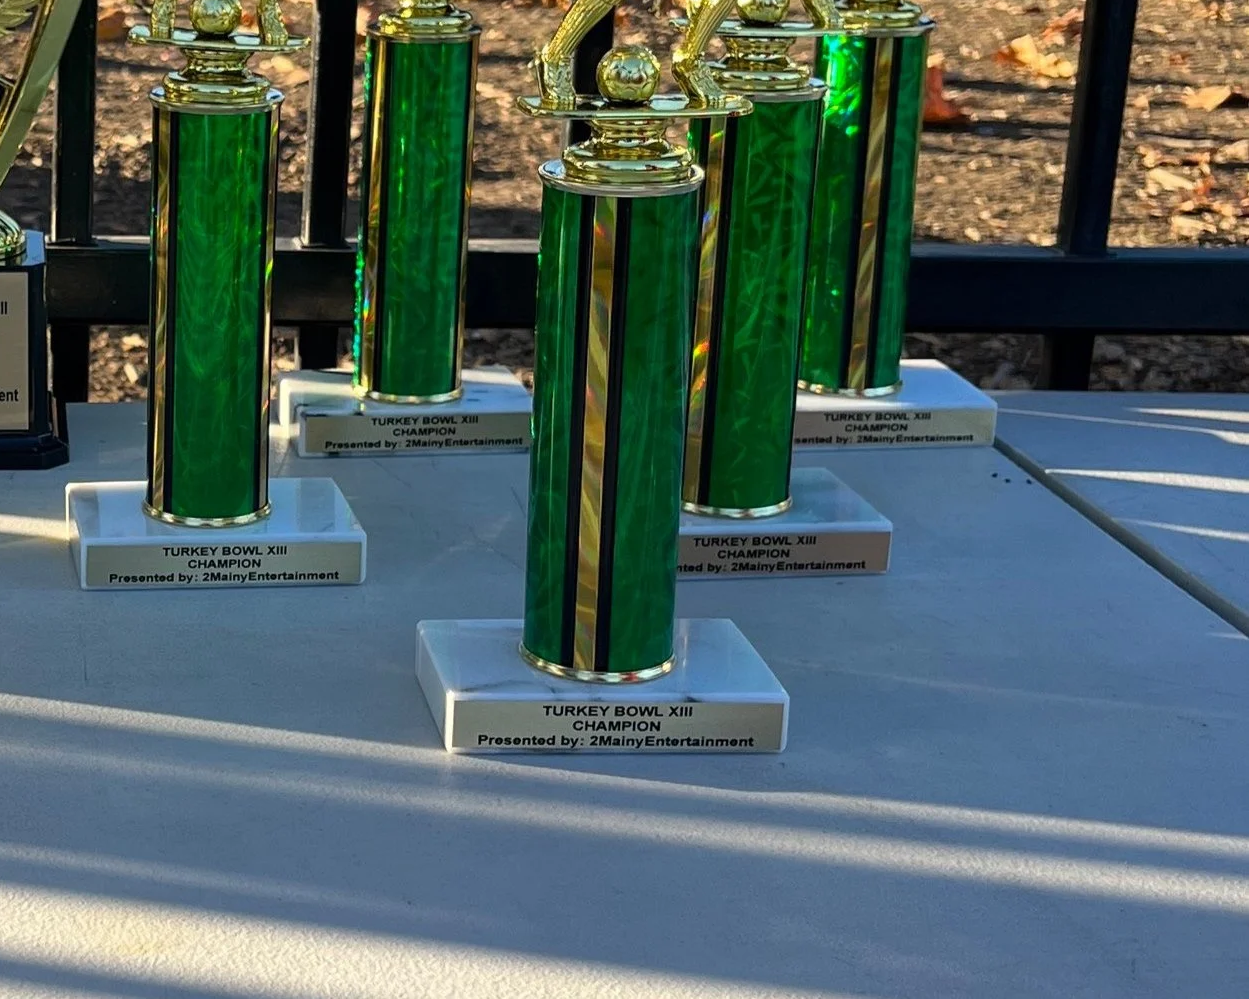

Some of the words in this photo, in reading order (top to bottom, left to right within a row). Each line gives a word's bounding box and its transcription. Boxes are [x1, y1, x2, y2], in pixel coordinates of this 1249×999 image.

[372, 417, 420, 426] TURKEY
[423, 416, 457, 425] BOWL
[461, 416, 478, 424] XIII
[824, 413, 871, 422] TURKEY
[875, 413, 910, 421] BOWL
[914, 412, 931, 420] XIII
[393, 428, 456, 436] CHAMPION
[845, 424, 908, 432] CHAMPION
[325, 441, 381, 449] Presented
[406, 438, 523, 450] 2MainyEntertainment
[794, 436, 832, 444] sented
[693, 537, 748, 547] TURKEY
[752, 537, 791, 546] BOWL
[797, 536, 817, 545] XIII
[163, 547, 218, 556] TURKEY
[222, 546, 262, 556] BOWL
[267, 546, 287, 554] XIII
[717, 550, 790, 558] CHAMPION
[188, 559, 261, 568] CHAMPION
[708, 562, 726, 574] by:
[731, 561, 866, 572] 2MainyEntertainment
[109, 573, 174, 583] Presented
[178, 572, 198, 584] by:
[202, 571, 339, 583] 2MainyEntertainment
[543, 706, 610, 717] TURKEY
[614, 706, 663, 717] BOWL
[669, 706, 692, 717] XIII
[572, 720, 661, 732] CHAMPION
[478, 734, 555, 746] Presented
[560, 735, 584, 748] by:
[590, 735, 754, 748] 2MainyEntertainment
